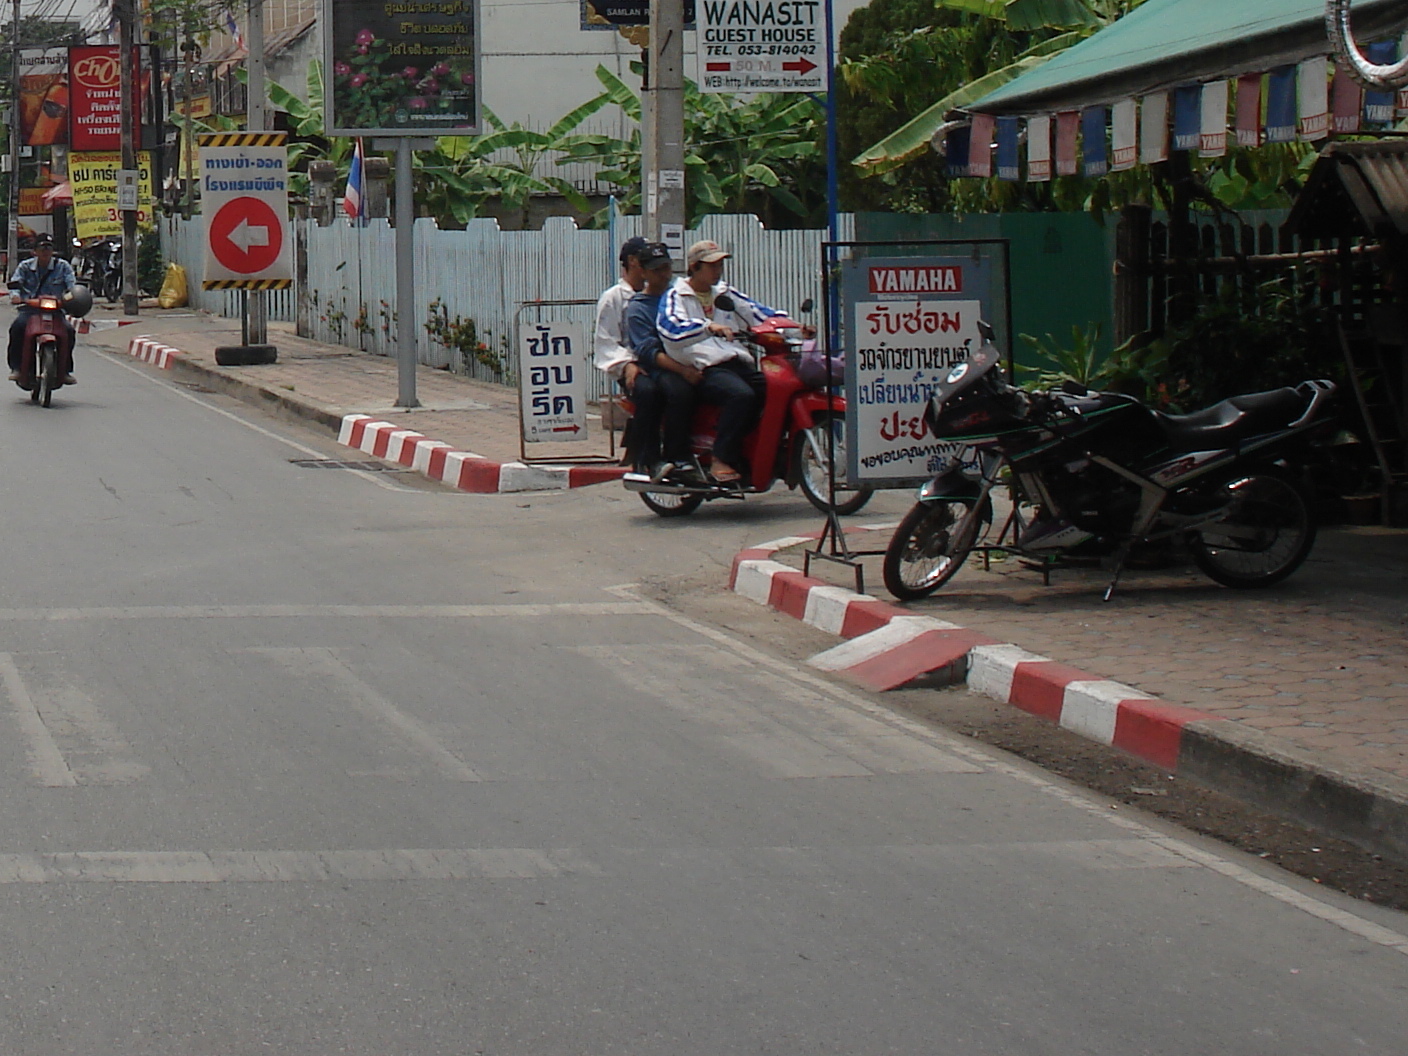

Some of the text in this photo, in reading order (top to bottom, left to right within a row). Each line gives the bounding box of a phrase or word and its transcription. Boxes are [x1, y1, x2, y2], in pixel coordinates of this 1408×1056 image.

[607, 8, 641, 16] SAMLAN
[703, 0, 819, 26] WANASIT
[705, 29, 815, 42] GUEST HOUSE
[706, 45, 816, 56] TEL. 053-814042
[735, 60, 777, 72] 50 M.
[205, 153, 283, 169] ทางเข้า-ออก
[872, 268, 957, 292] YAMAHA
[866, 301, 961, 335] รับซ่อม
[526, 325, 572, 356] ซัก
[530, 365, 573, 385] อบ
[531, 387, 574, 416] รีด
